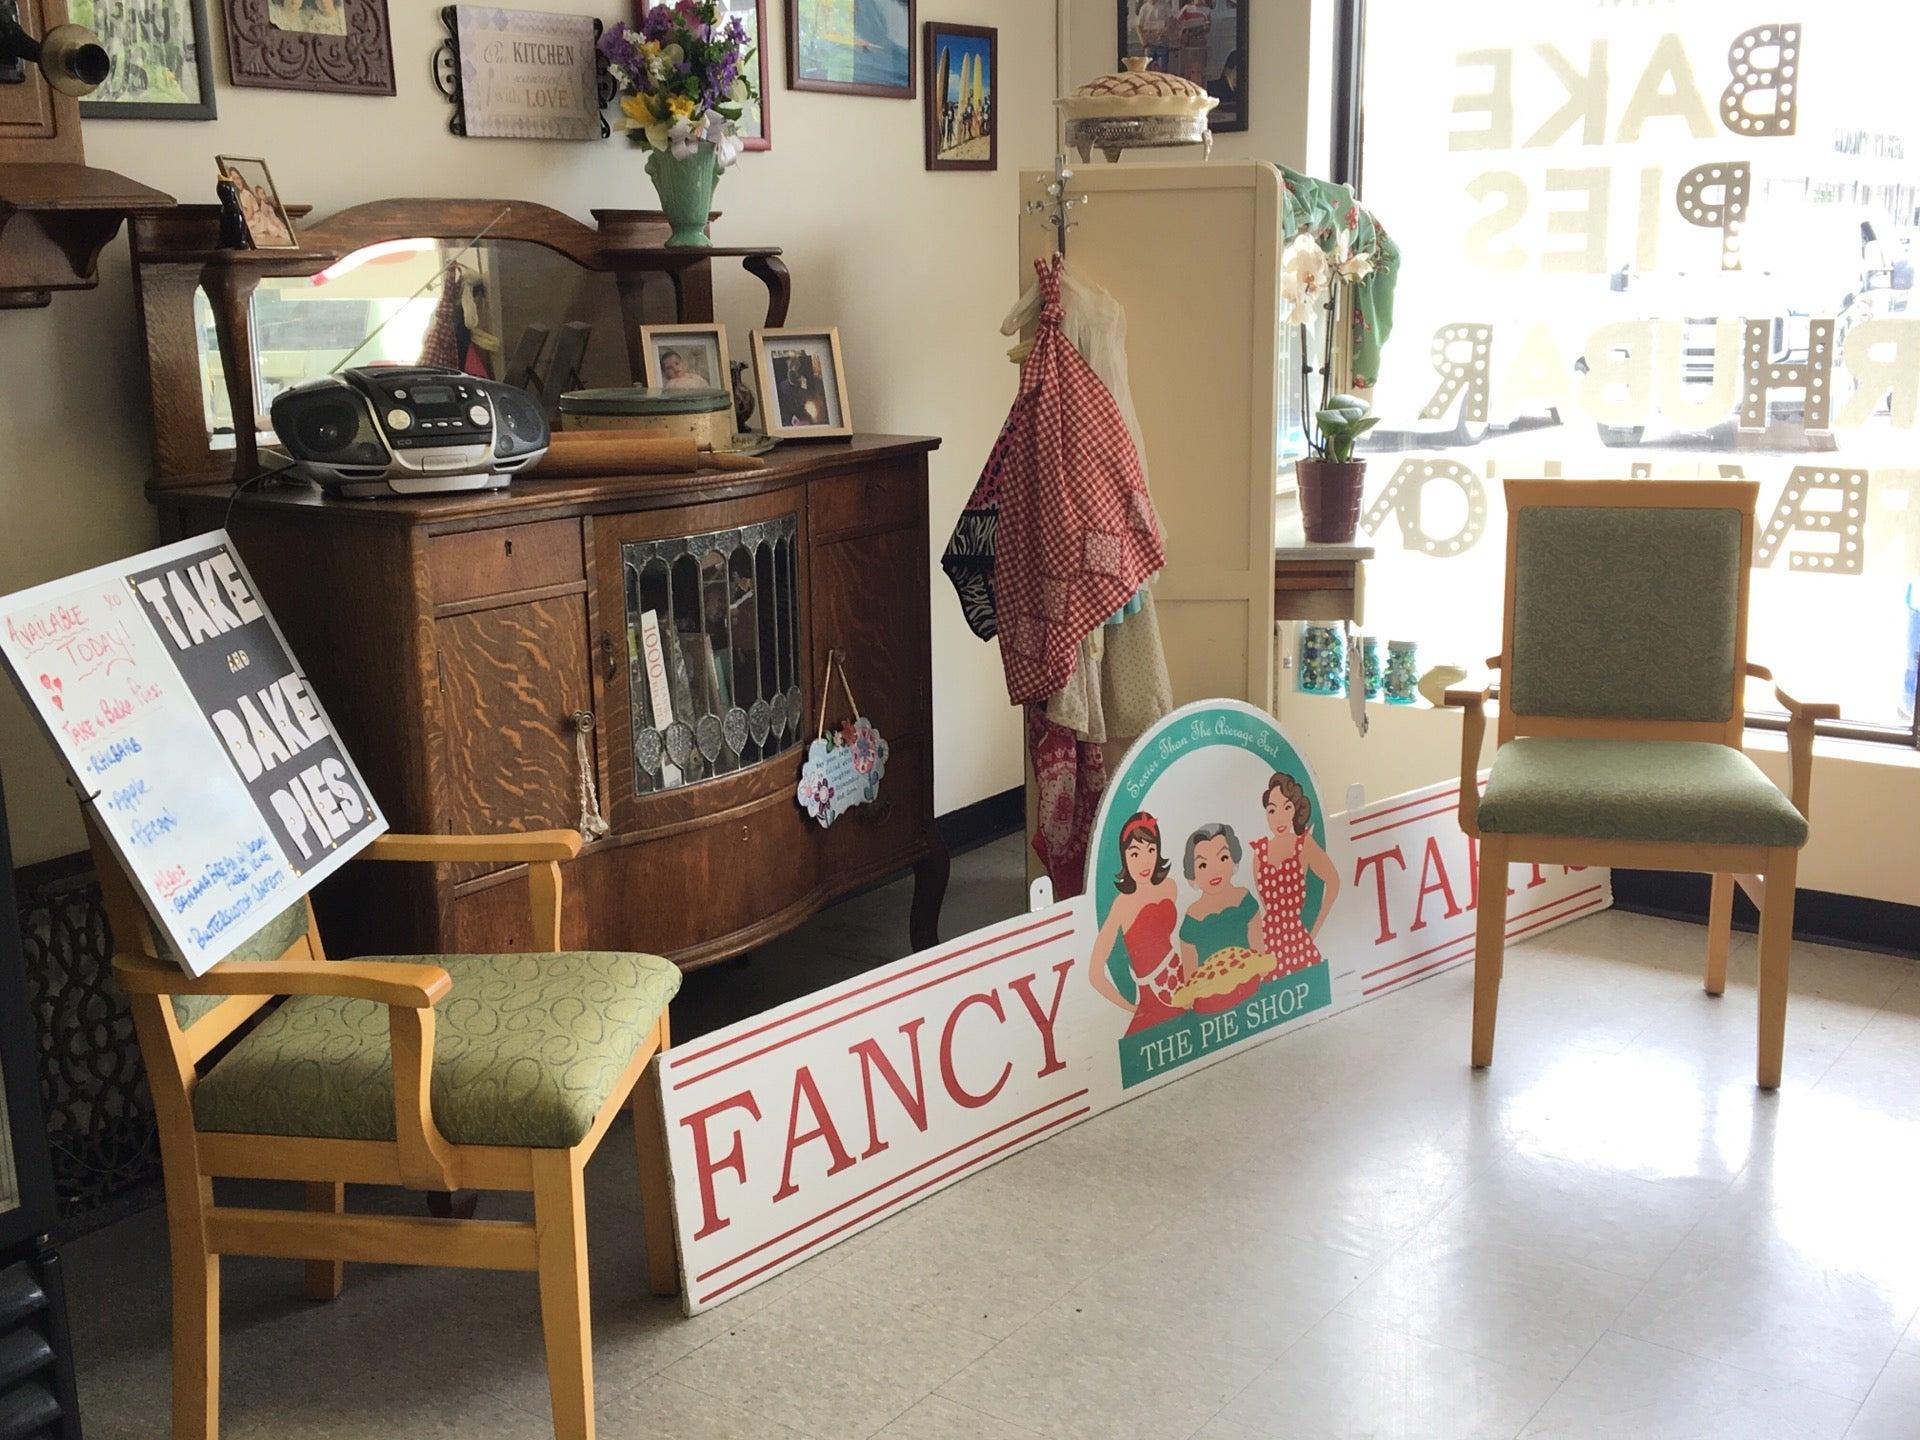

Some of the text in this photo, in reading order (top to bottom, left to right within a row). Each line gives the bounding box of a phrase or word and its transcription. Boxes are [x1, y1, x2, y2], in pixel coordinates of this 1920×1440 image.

[512, 42, 575, 66] KITCHEN
[526, 89, 570, 108] LOVE
[136, 552, 265, 651] TAKE
[7, 605, 89, 649] AVAILABLE
[226, 649, 251, 674] AND
[643, 625, 664, 679] 1000
[211, 673, 331, 784] BAKE
[1158, 735, 1188, 759] Than
[1190, 719, 1212, 741] The
[1214, 715, 1254, 747] Average
[1256, 729, 1279, 759] Tart
[269, 756, 366, 861] PIES
[173, 875, 210, 913] BANANA
[1140, 982, 1310, 1073] THE PIE SHOP
[679, 958, 1076, 1242] FANCY
